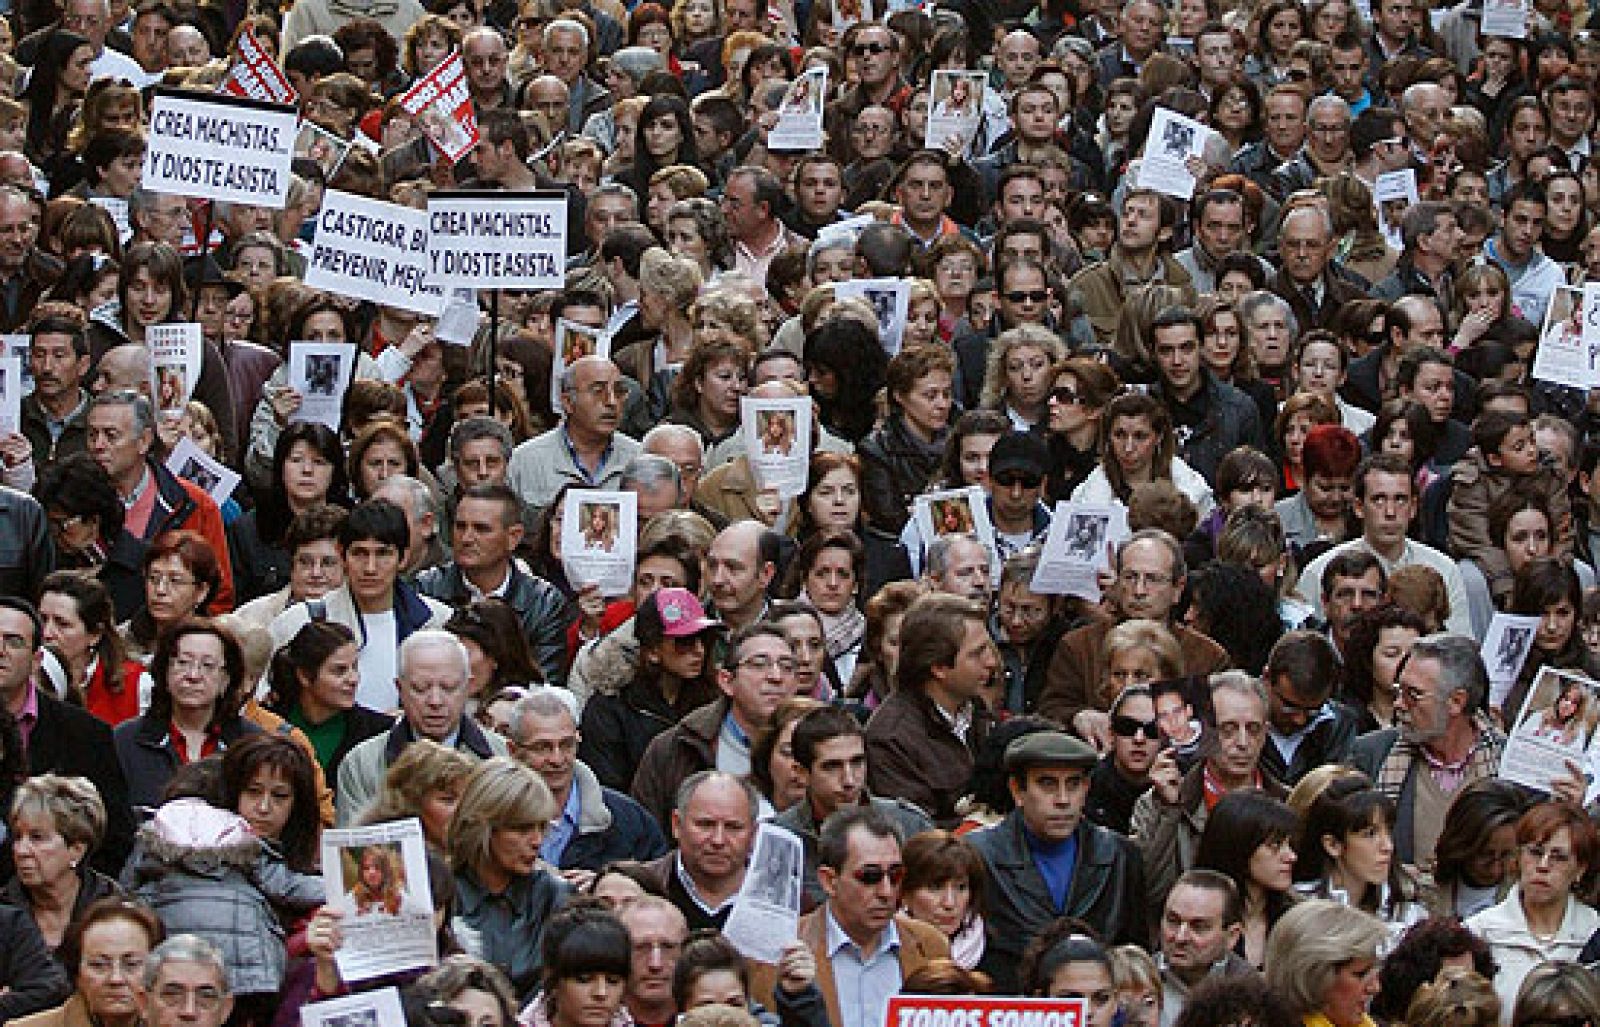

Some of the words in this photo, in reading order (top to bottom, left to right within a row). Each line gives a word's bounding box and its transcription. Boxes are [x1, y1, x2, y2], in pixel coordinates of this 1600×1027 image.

[154, 110, 192, 140] CREA
[151, 151, 160, 177] Y
[322, 209, 408, 253] CASTIGAR,
[430, 211, 468, 236] CREA
[311, 244, 388, 288] PREVENIR,
[430, 249, 440, 274] Y
